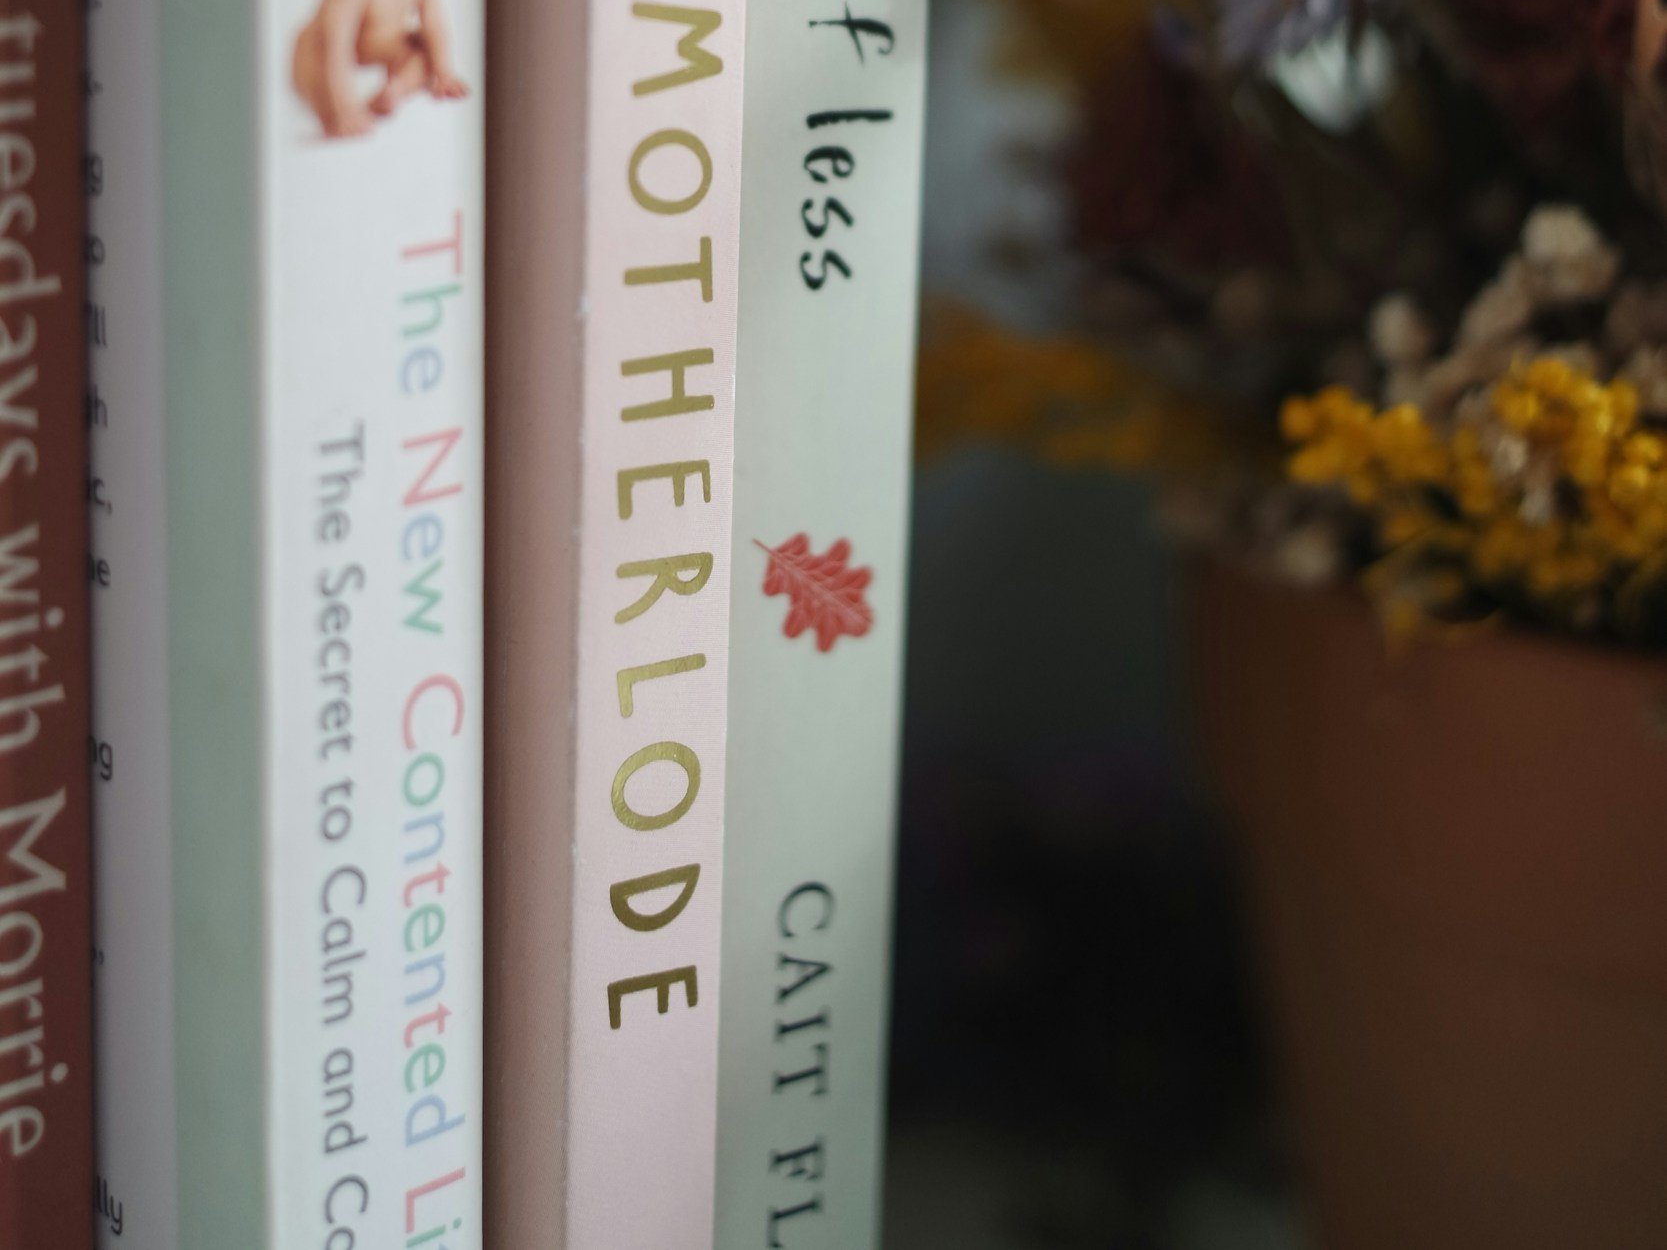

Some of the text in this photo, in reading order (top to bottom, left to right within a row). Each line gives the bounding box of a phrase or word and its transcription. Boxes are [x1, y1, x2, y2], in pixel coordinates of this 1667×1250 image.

[800, 108, 894, 291] less
[315, 417, 366, 545] The
[607, 0, 724, 1031] MOTHERLODE
[0, 523, 65, 752] with
[317, 563, 365, 761] Secret
[400, 209, 466, 1250] The New Contented Li
[319, 777, 356, 844] to
[0, 785, 67, 1158] Morrie
[320, 863, 367, 1027] Calm
[772, 879, 838, 1096] CAIT
[323, 1046, 369, 1154] and
